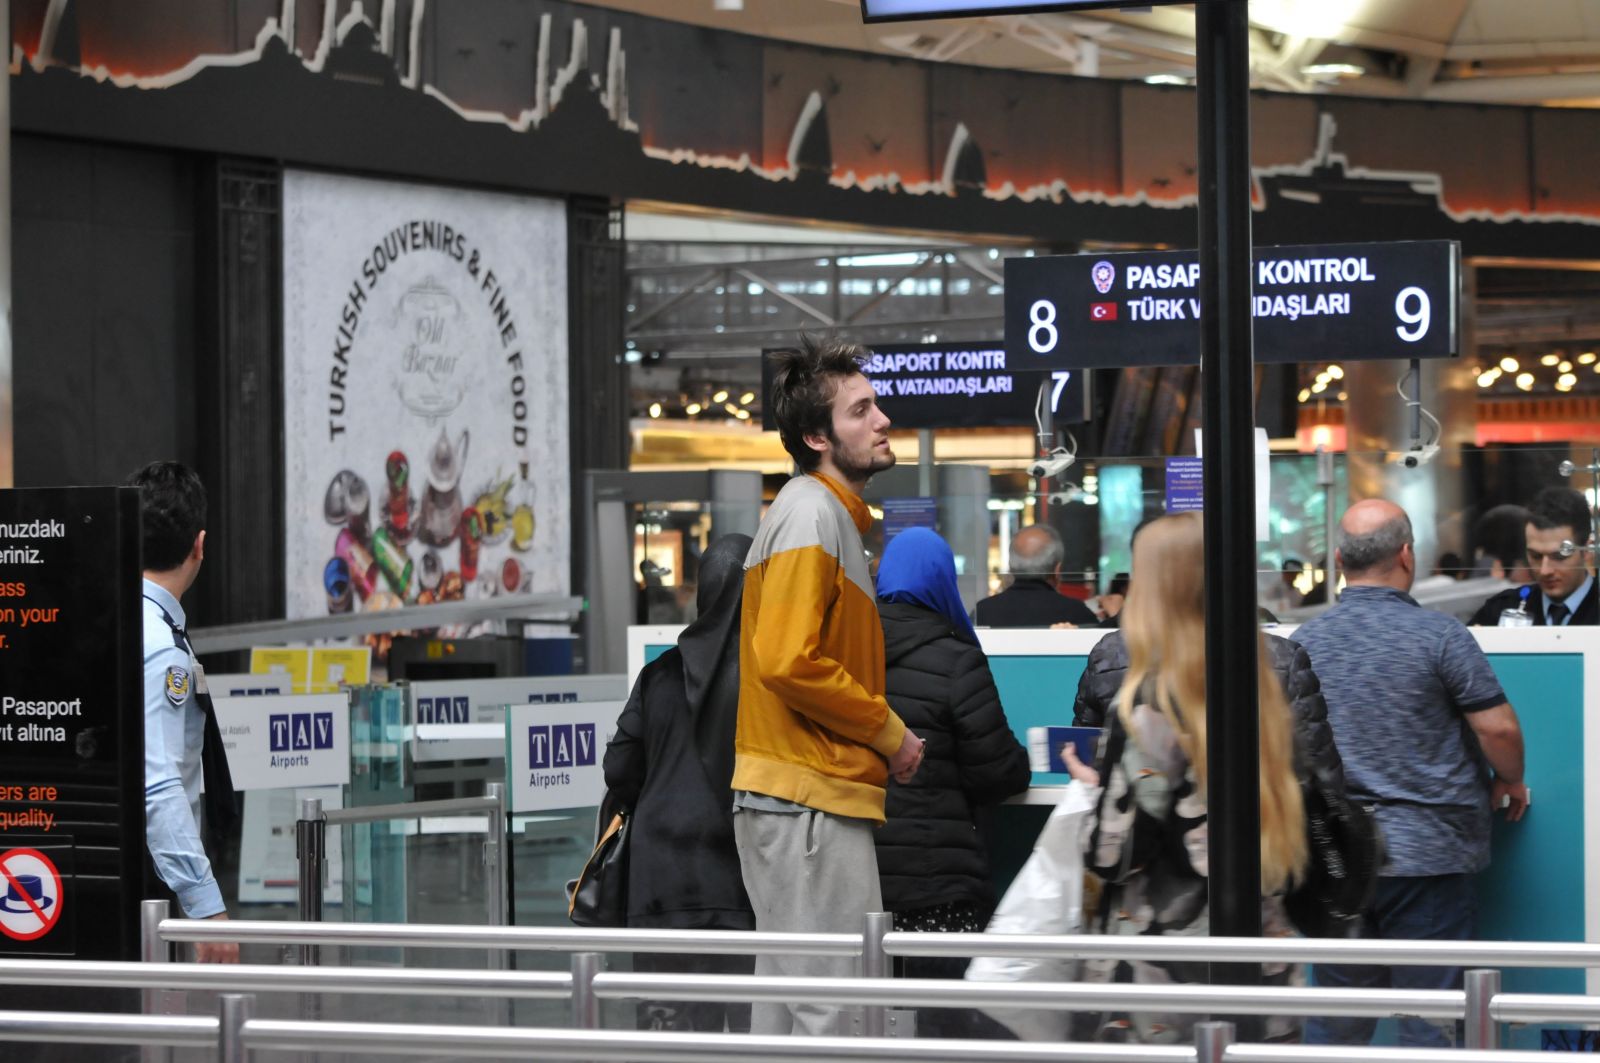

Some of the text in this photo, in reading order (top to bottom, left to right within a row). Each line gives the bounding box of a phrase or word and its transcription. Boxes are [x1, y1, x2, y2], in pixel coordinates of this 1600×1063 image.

[1126, 257, 1376, 290] PASAP KONTROL
[1127, 297, 1186, 321] TÜRK
[1395, 286, 1431, 342] 9
[329, 220, 529, 448] TURKISH SOUVENIRS & FINE FOOD
[1028, 299, 1058, 354] 8
[945, 350, 1005, 370] KONTR
[895, 375, 1013, 397] VATANDAŞLARI
[1051, 371, 1070, 413] 7
[19, 607, 61, 628] your
[2, 696, 82, 720] Pasaport
[419, 700, 468, 724] TAV
[17, 722, 66, 742] altına
[271, 716, 332, 750] TAV
[530, 727, 594, 766] TAV
[270, 756, 309, 769] Airports
[529, 772, 570, 789] Airports
[28, 786, 57, 801] are
